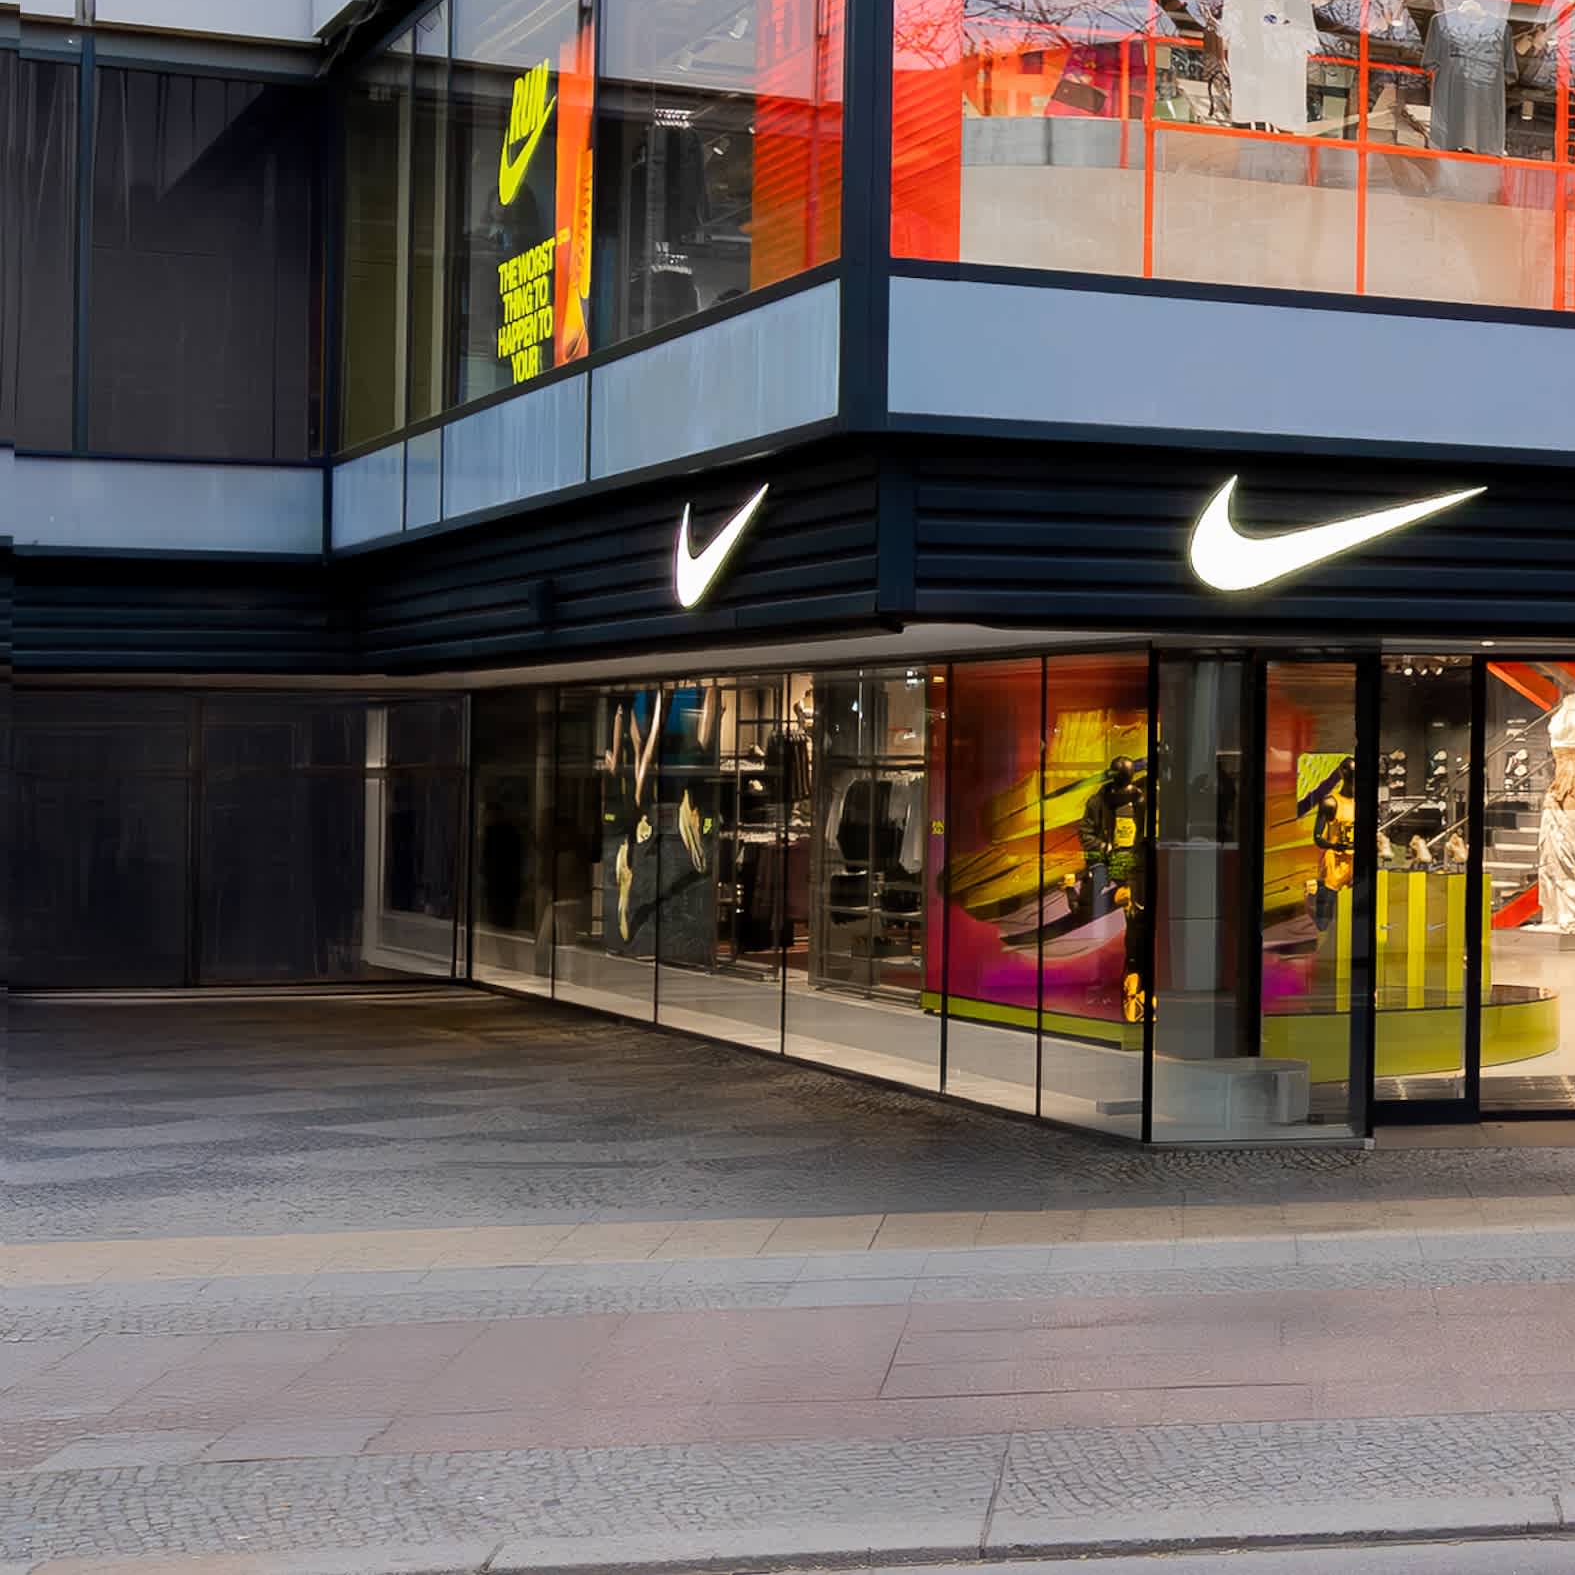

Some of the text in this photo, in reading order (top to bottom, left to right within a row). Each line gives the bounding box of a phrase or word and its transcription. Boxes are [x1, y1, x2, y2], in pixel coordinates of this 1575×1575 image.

[509, 58, 550, 146] RUN
[498, 259, 517, 295] THE
[517, 237, 555, 288] WORST
[502, 275, 549, 323] THING TO
[498, 305, 554, 359] HAPPEN TO
[511, 345, 540, 385] YOUR
